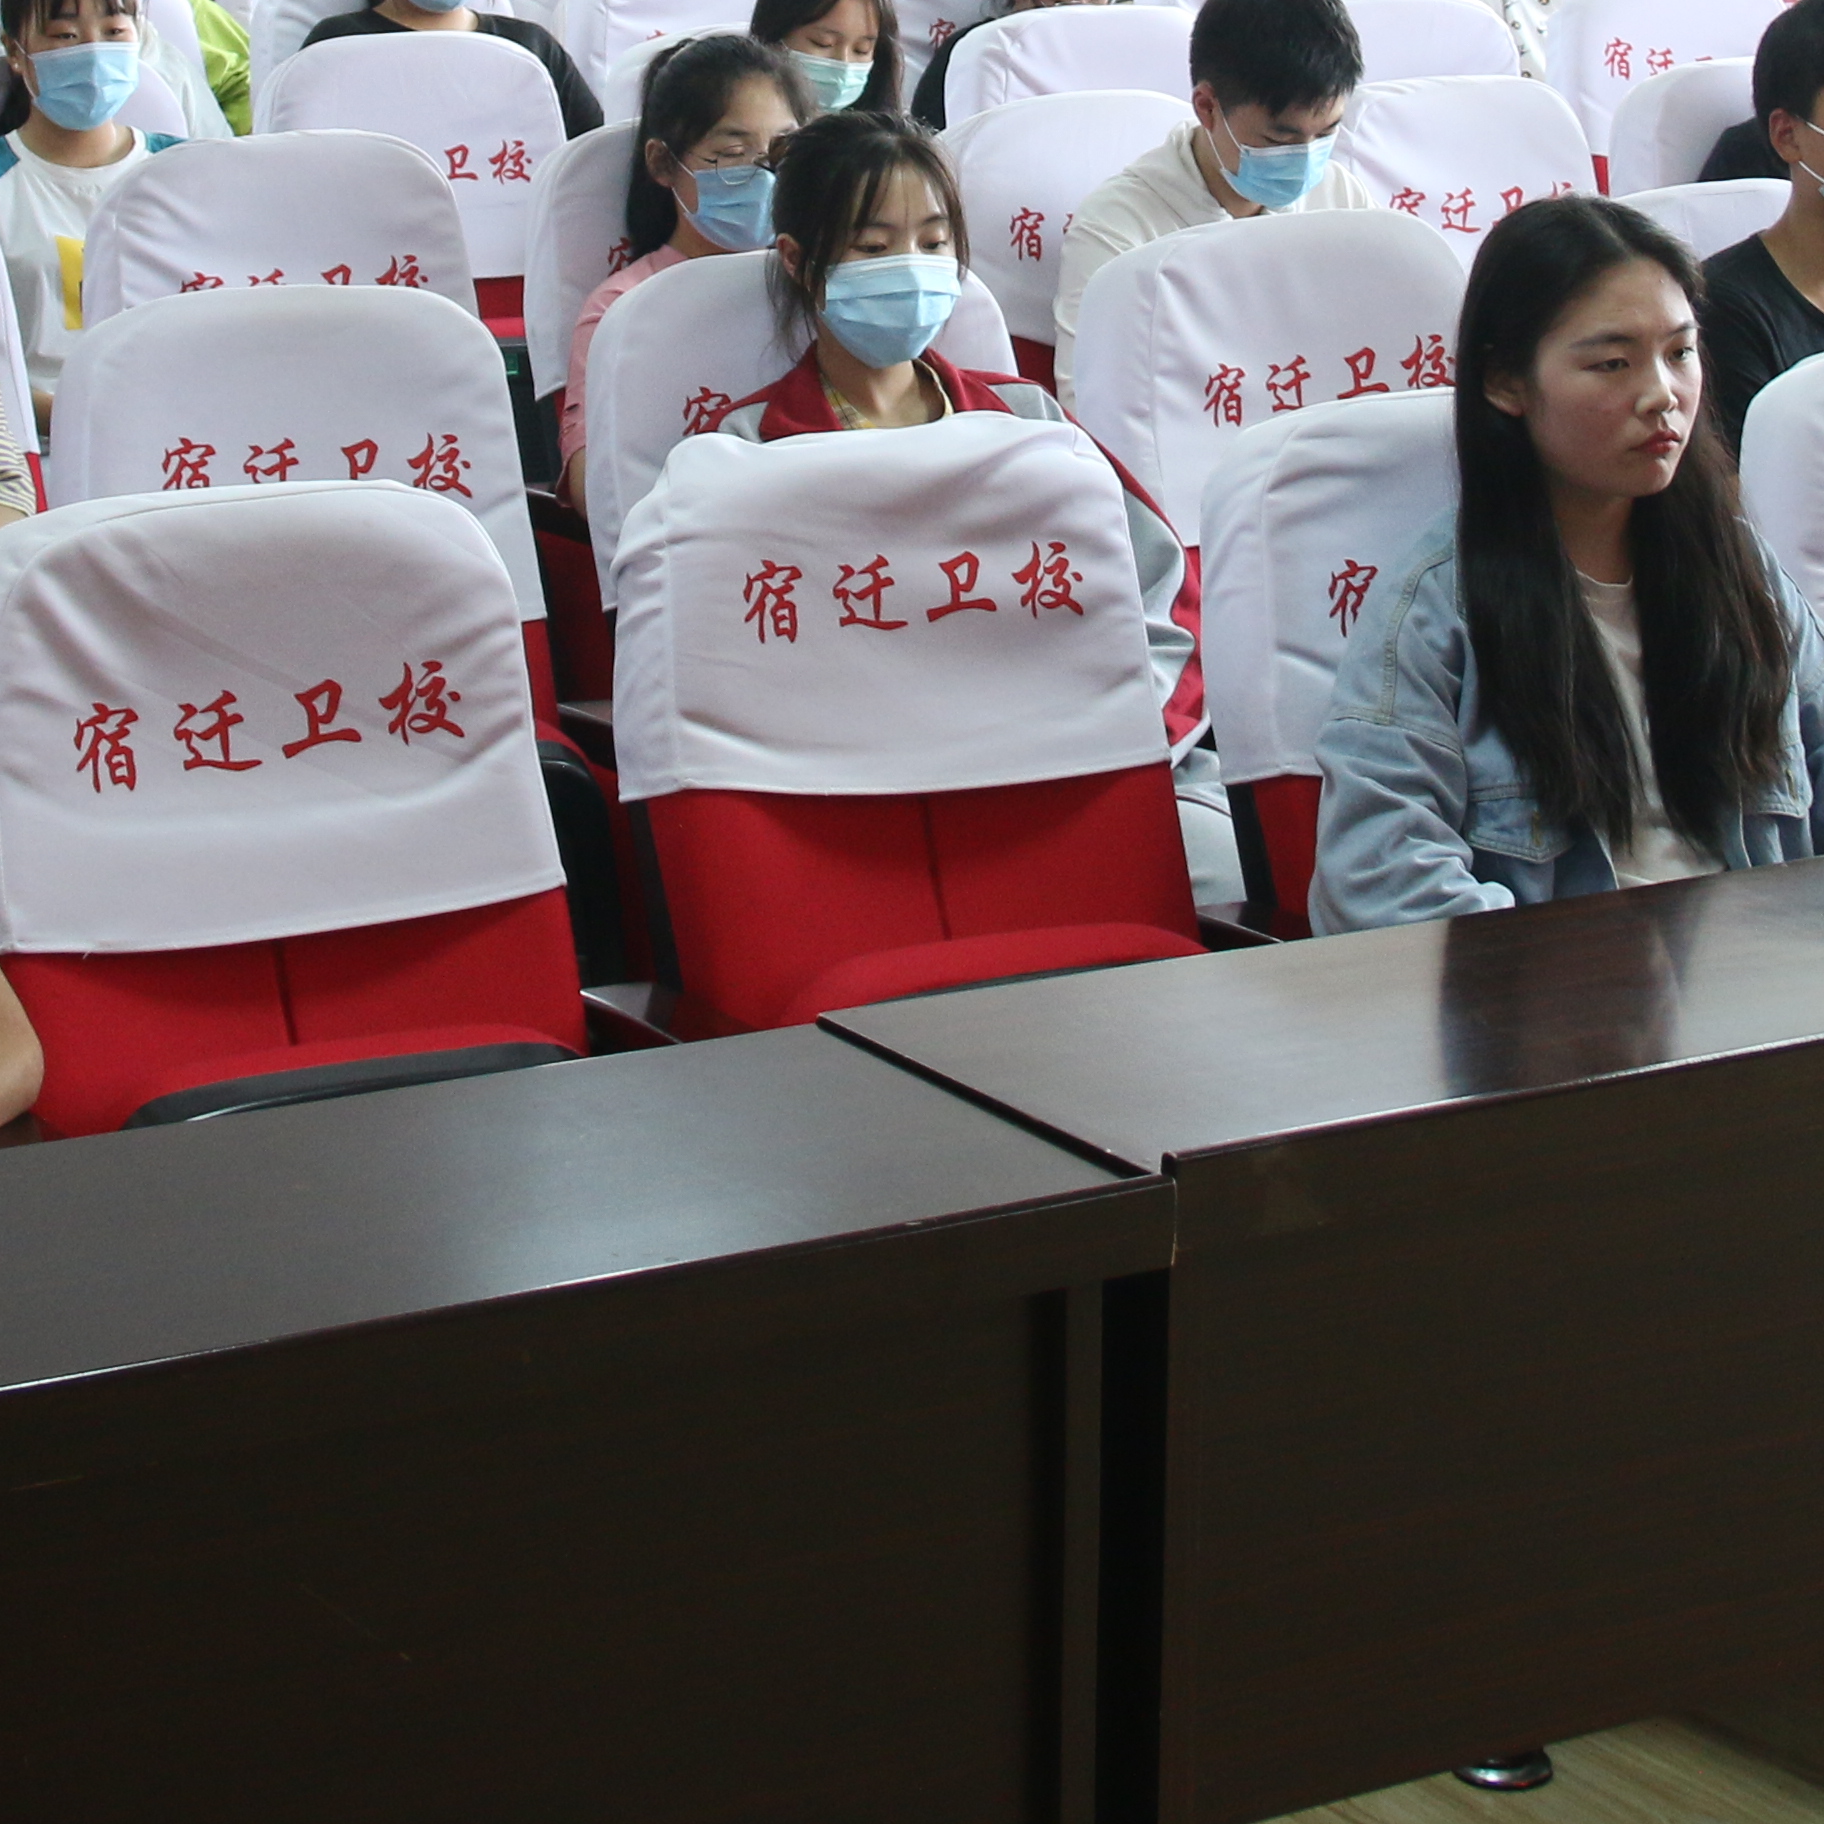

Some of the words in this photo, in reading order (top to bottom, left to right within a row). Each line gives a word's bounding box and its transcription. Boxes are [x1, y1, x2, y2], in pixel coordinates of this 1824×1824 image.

[1603, 37, 1714, 80] 宿迁
[1203, 332, 1457, 428] 宿迁卫校
[742, 540, 1086, 644] 宿迁卫校
[72, 659, 467, 794] 宿迁卫校
